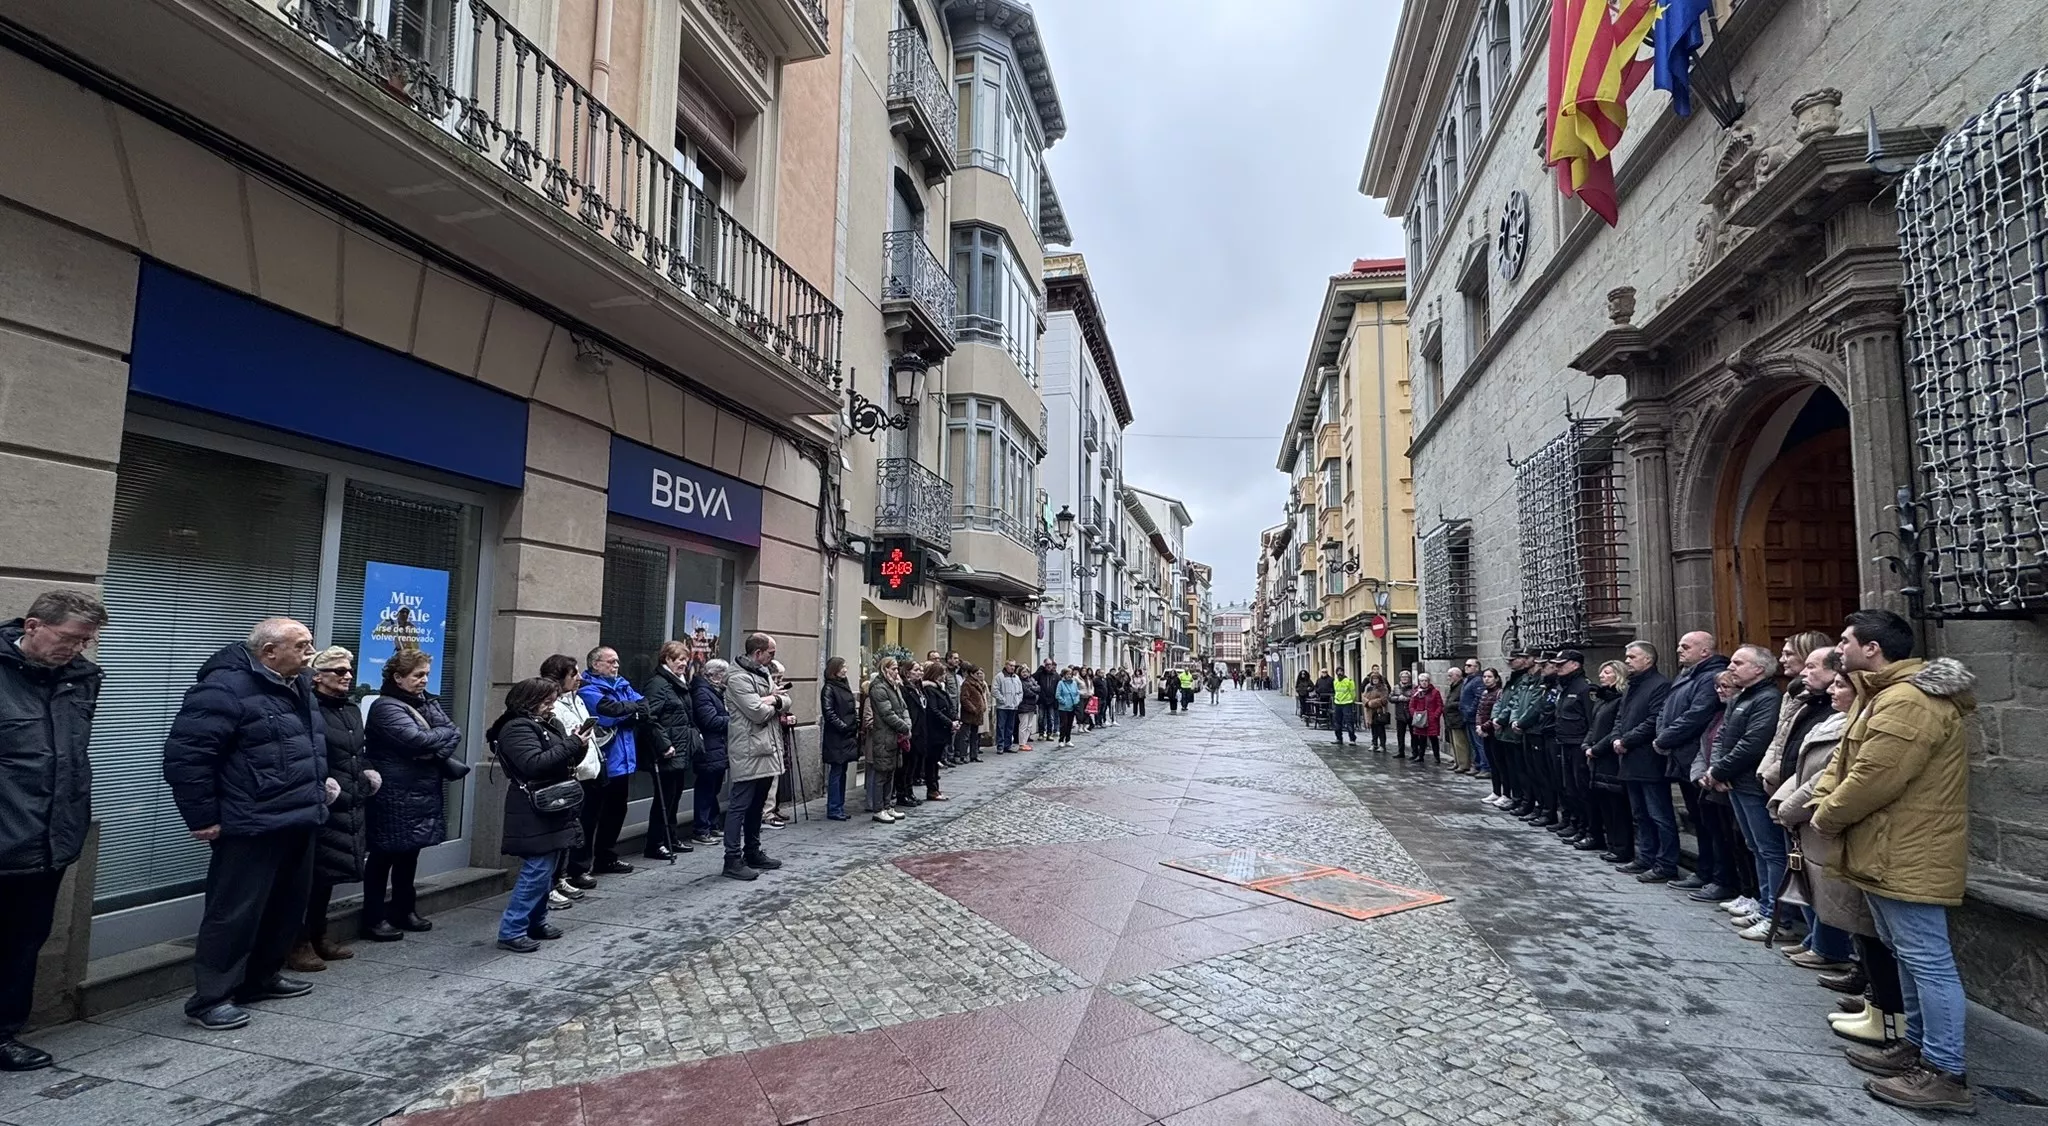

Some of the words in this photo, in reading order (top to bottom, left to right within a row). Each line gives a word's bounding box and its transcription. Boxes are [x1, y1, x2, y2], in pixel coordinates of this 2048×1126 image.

[652, 468, 732, 521] BBVA
[881, 562, 913, 575] 12:03
[390, 591, 424, 609] Muy
[380, 606, 397, 621] de
[407, 609, 430, 622] Ale
[393, 623, 404, 634] de
[405, 625, 425, 635] finde
[426, 628, 432, 637] y
[371, 633, 397, 641] volver
[398, 635, 434, 643] renovado
